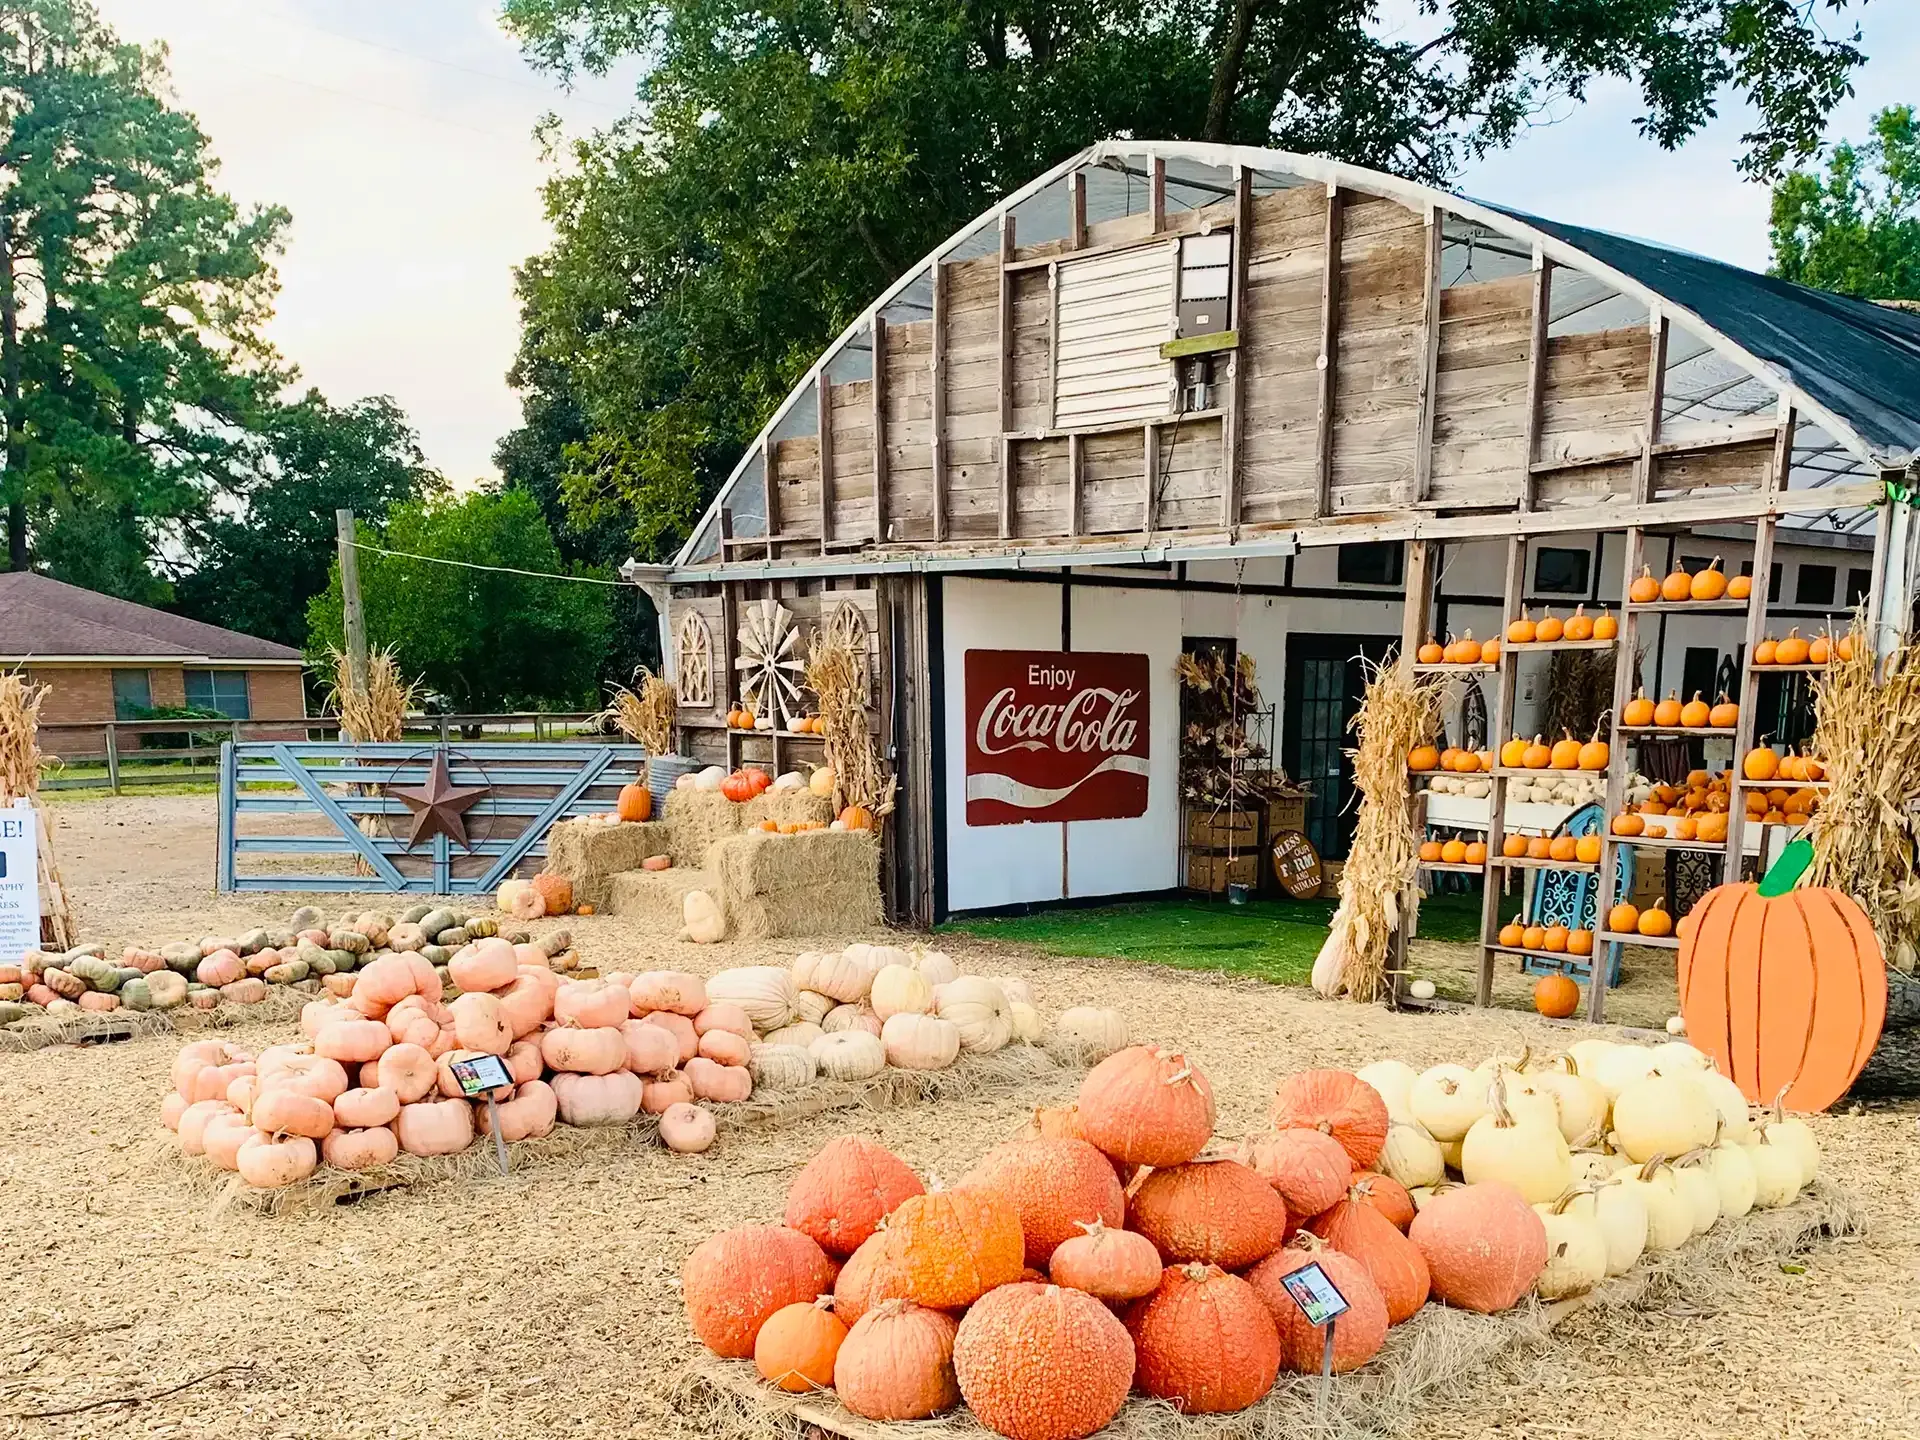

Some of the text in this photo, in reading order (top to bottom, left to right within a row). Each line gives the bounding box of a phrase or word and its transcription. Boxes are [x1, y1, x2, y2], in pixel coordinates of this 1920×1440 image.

[1028, 664, 1076, 690] Enjoy
[976, 687, 1141, 755] Coca-Cola
[1273, 833, 1301, 859] BLESS
[1294, 844, 1310, 858] OUR
[1290, 875, 1322, 895] ANIMALS
[1296, 871, 1310, 882] AND
